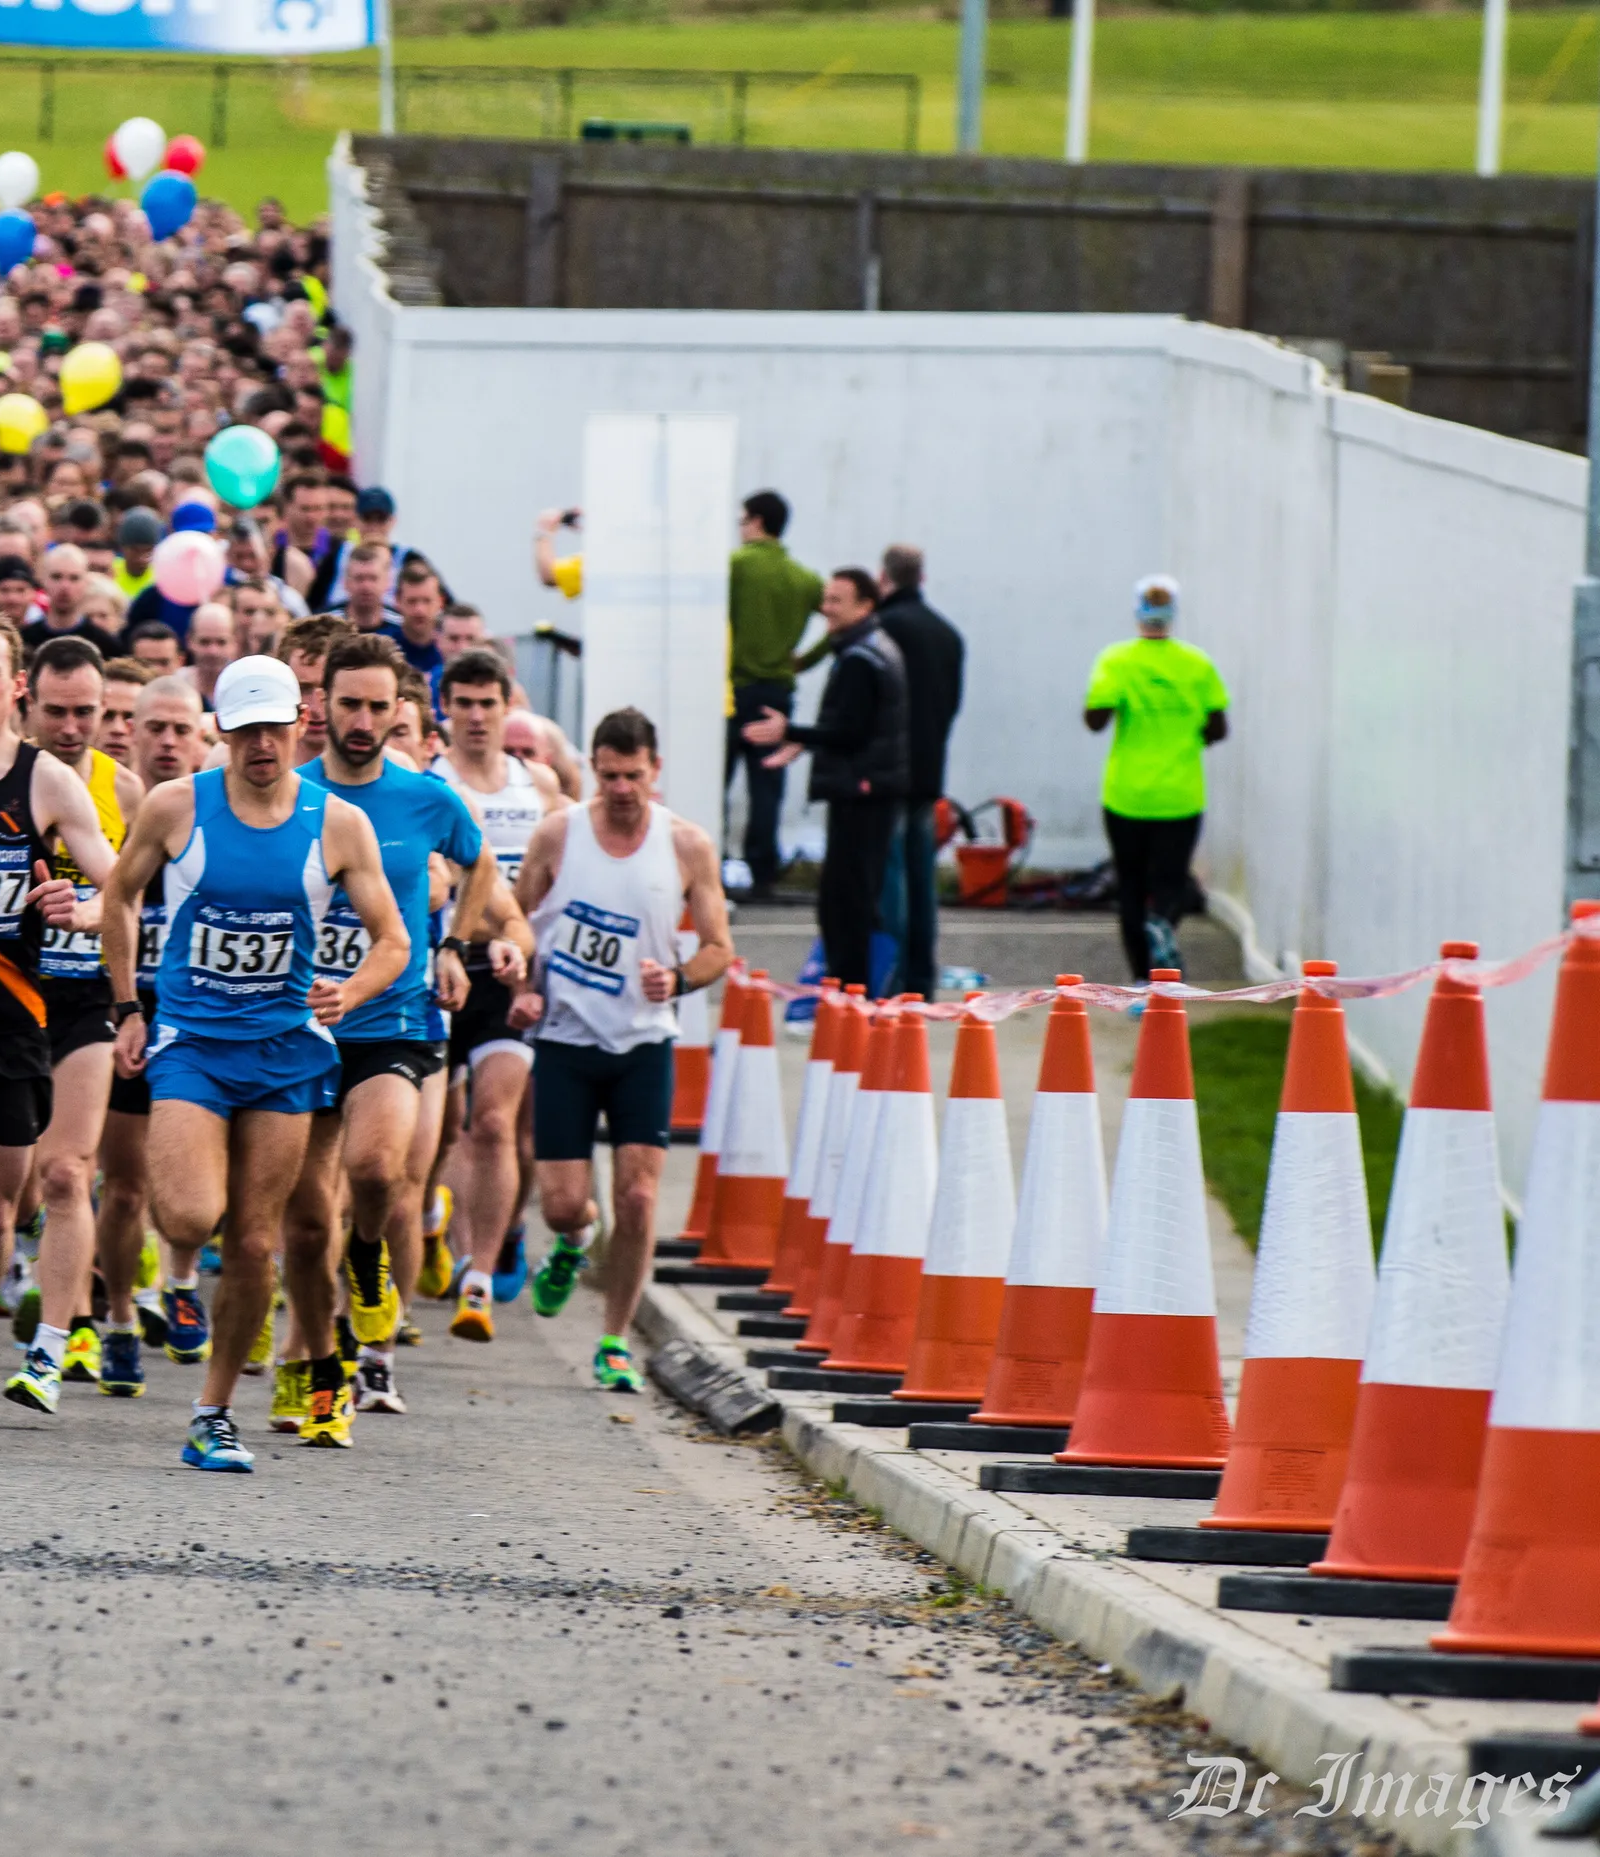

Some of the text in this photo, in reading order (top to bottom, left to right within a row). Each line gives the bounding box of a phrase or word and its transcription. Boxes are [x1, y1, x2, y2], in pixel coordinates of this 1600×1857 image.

[198, 926, 294, 974] 1537
[319, 926, 362, 969] 36
[569, 923, 622, 968] 130
